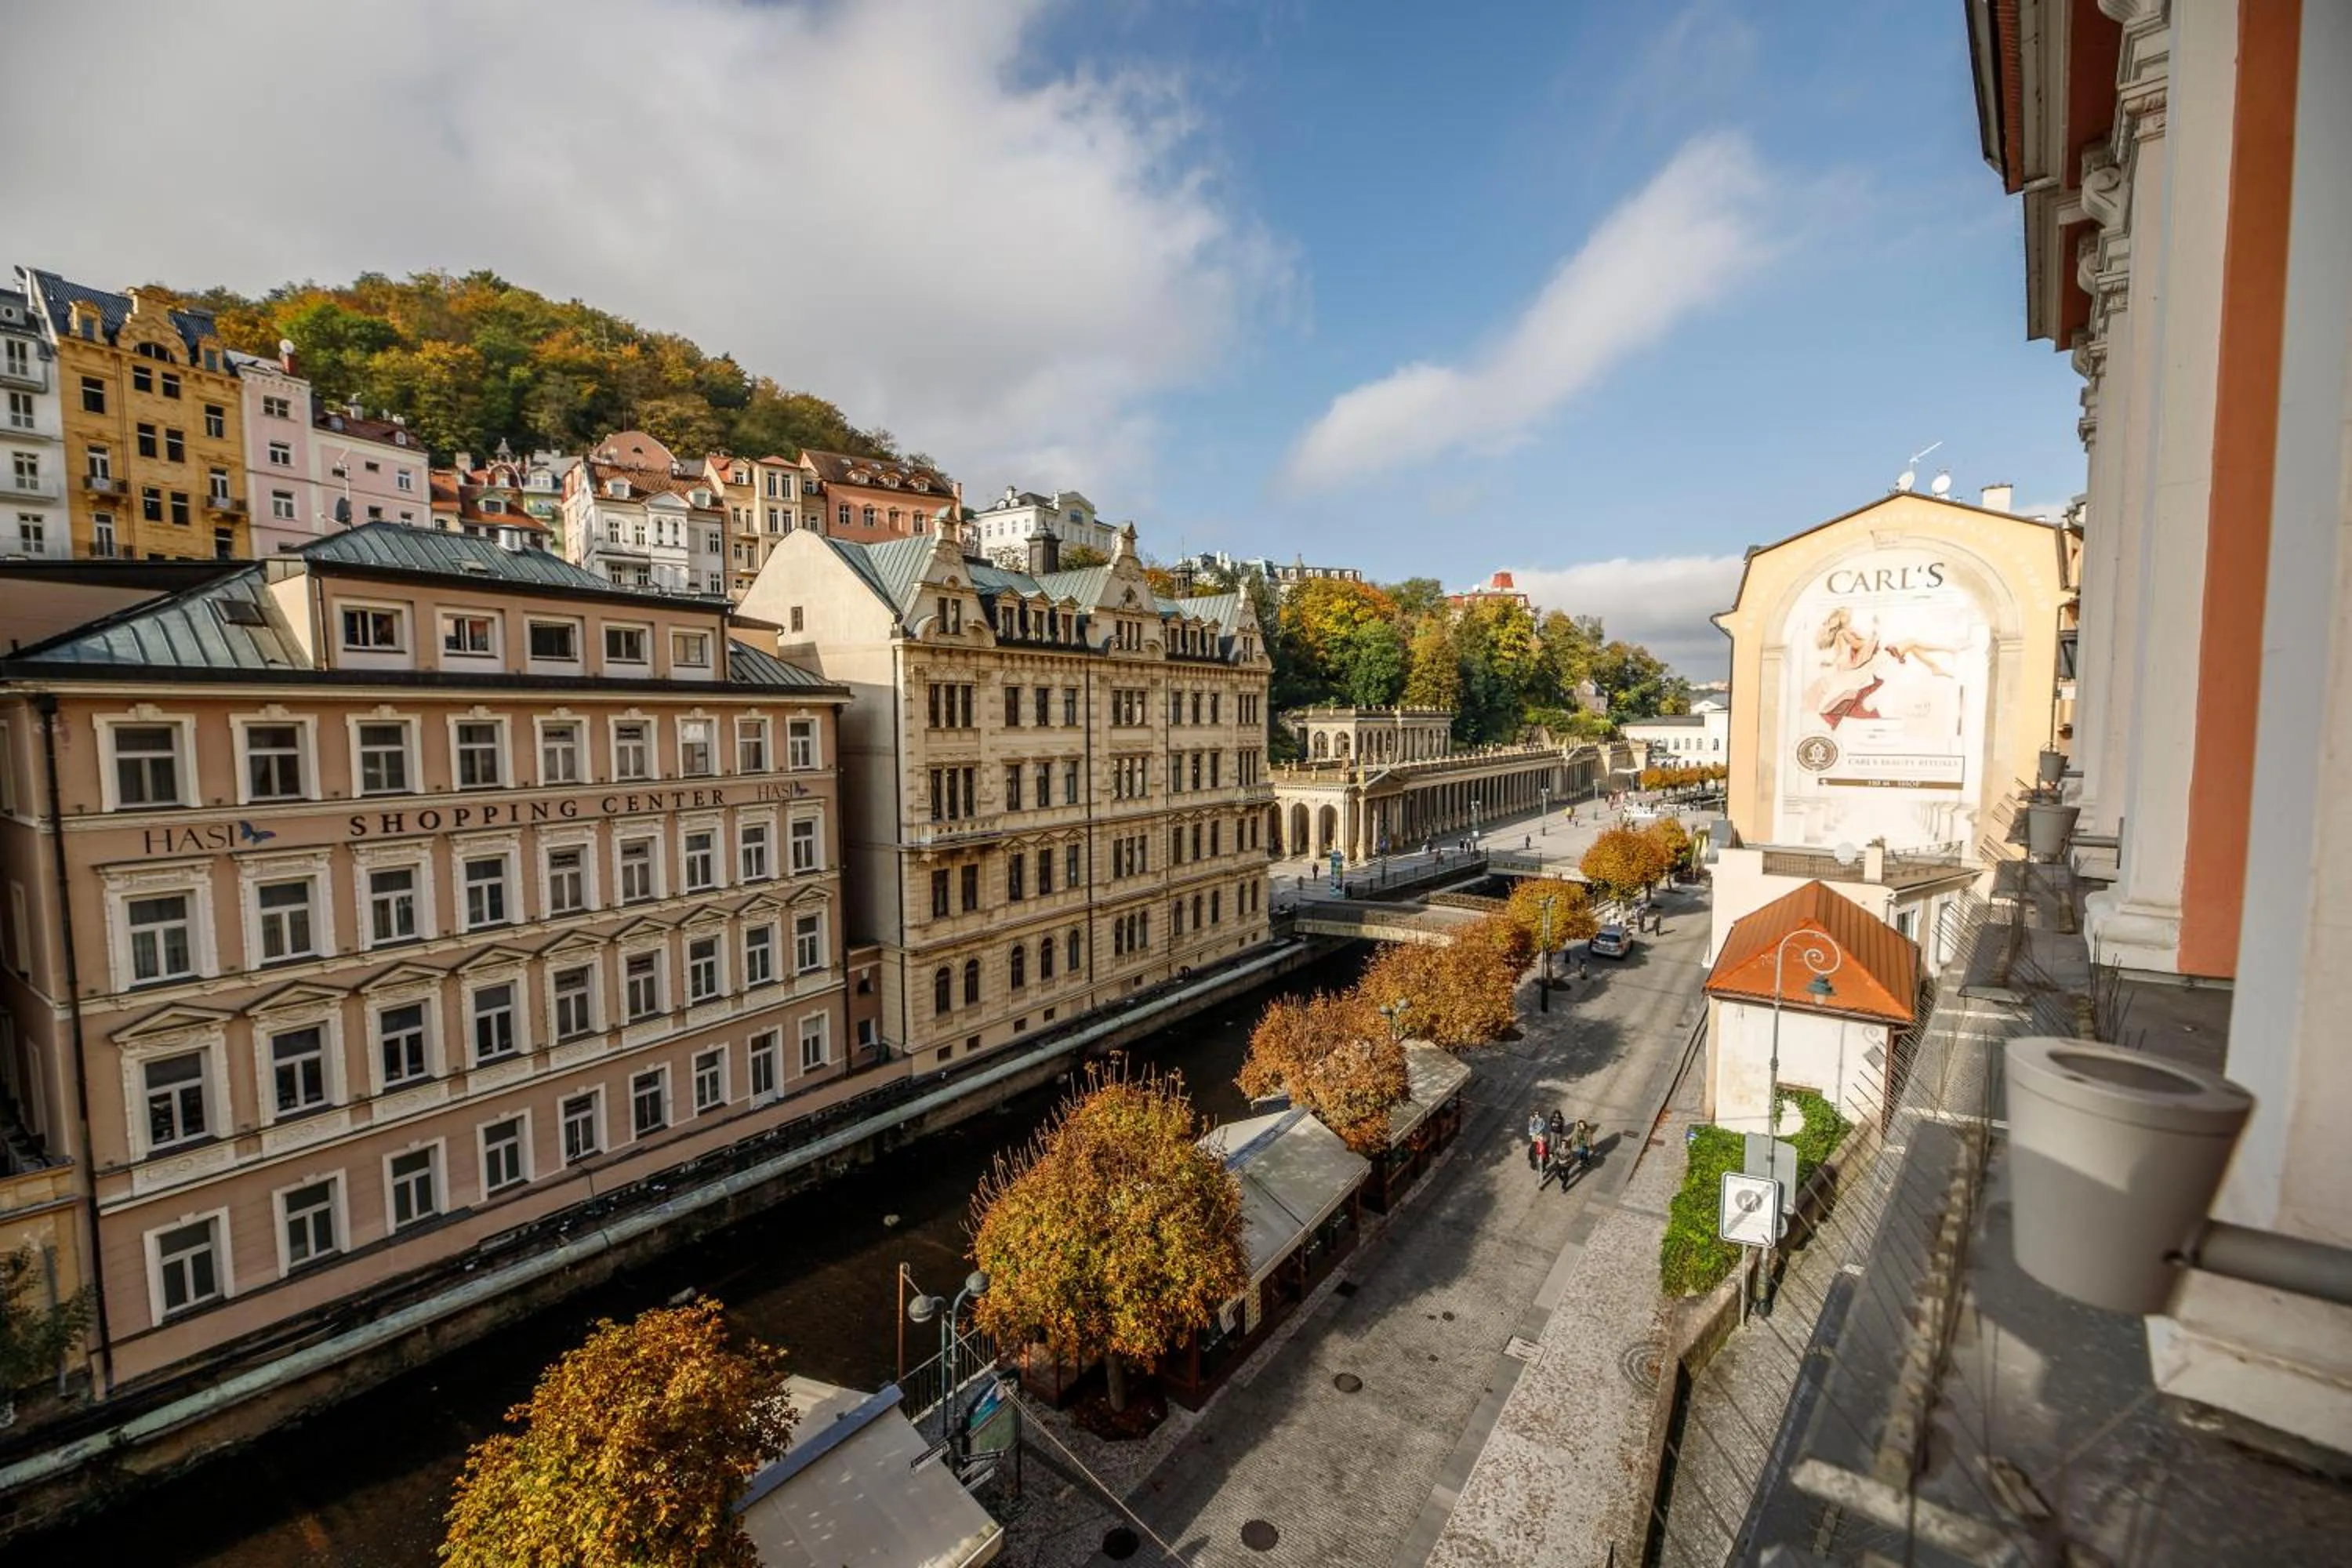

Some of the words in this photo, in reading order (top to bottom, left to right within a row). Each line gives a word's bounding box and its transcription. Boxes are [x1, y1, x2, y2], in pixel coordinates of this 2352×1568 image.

[1827, 562, 1945, 594] CARL'S
[757, 782, 793, 801] HASI
[350, 800, 578, 837] SHOPPING
[601, 789, 725, 814] CENTER
[144, 825, 234, 855] HASI
